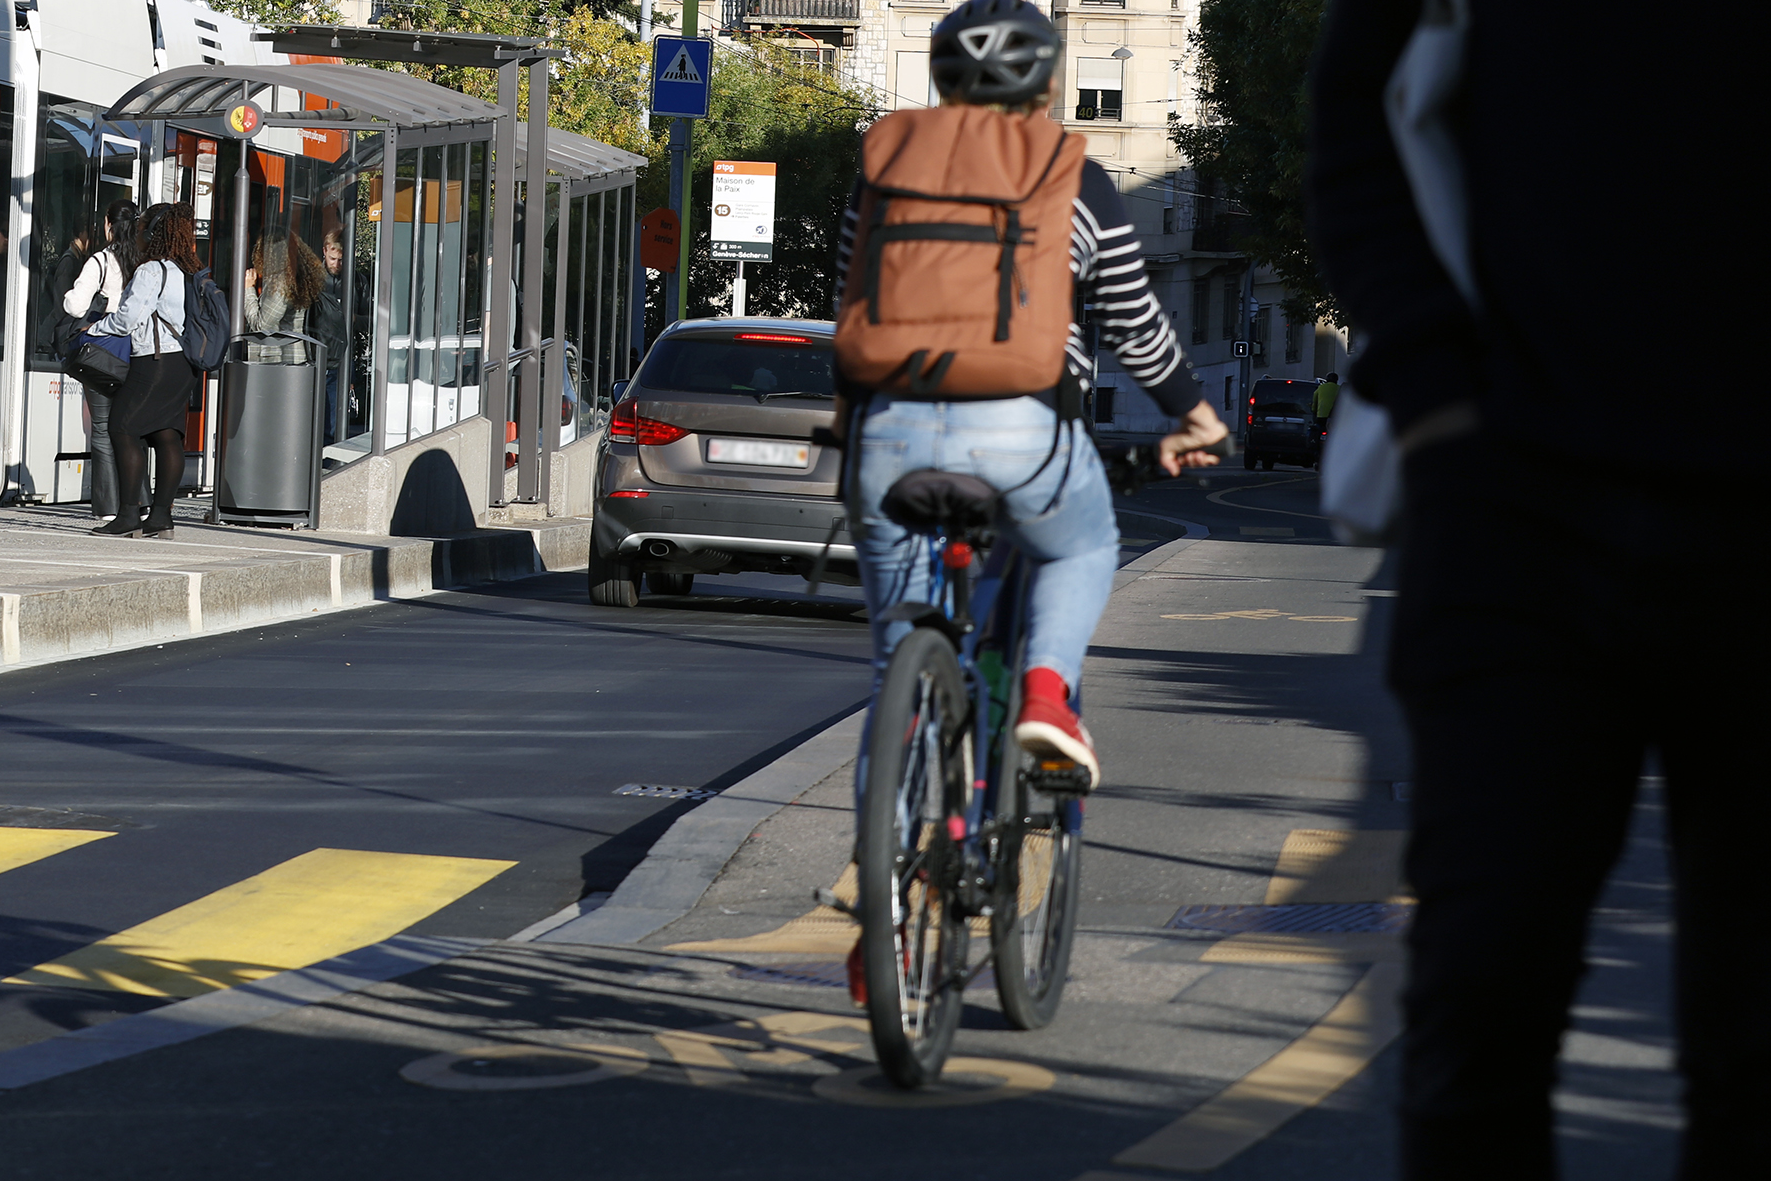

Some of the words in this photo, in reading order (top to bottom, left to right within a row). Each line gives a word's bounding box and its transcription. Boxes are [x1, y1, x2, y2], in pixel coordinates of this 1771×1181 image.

[1078, 107, 1094, 118] 40
[722, 163, 735, 173] tpg
[715, 176, 743, 185] Maison
[724, 185, 741, 193] Paix
[716, 205, 729, 215] 15
[660, 220, 673, 231] Hors
[654, 234, 674, 245] service
